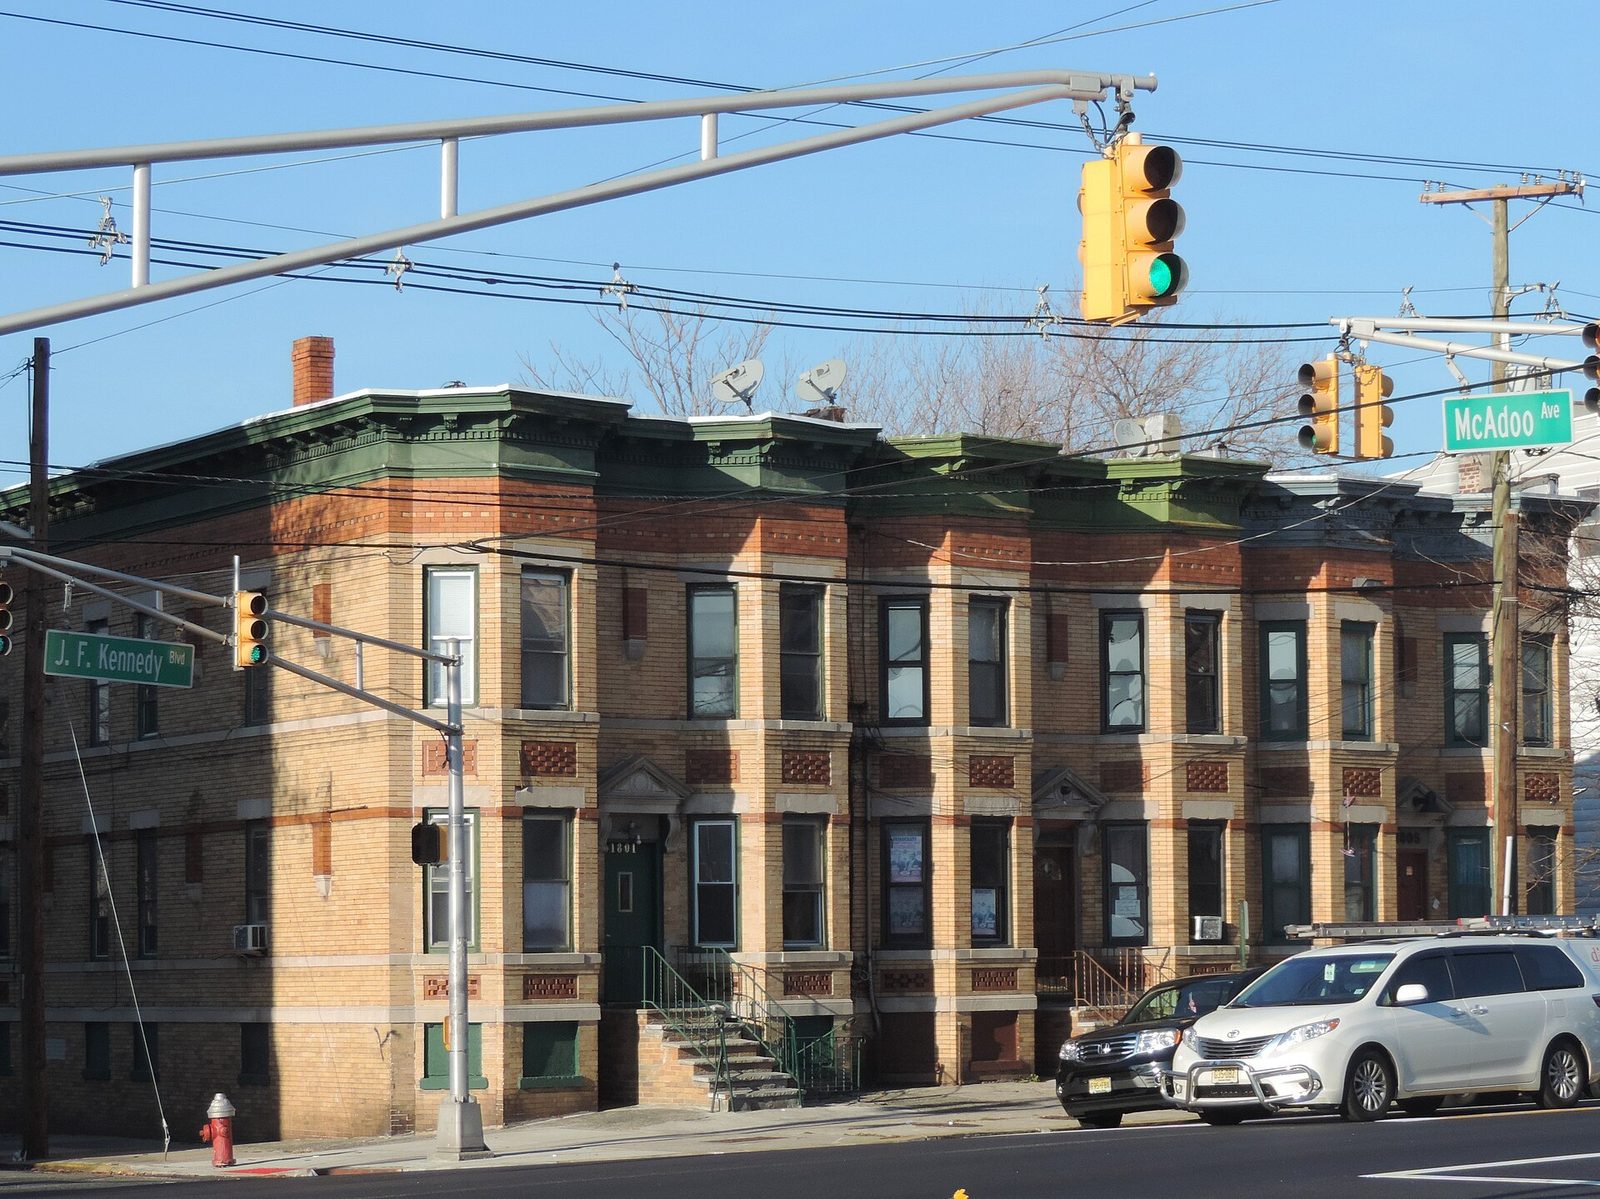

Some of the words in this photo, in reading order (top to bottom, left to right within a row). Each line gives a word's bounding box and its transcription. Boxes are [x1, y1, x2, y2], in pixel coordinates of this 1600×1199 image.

[1455, 405, 1534, 441] McAdoo
[1541, 402, 1560, 419] Ave
[54, 639, 69, 666] J.
[77, 641, 91, 668] F.
[98, 643, 164, 682] Kennedy
[168, 650, 186, 666] Blvd
[611, 843, 636, 853] 1801
